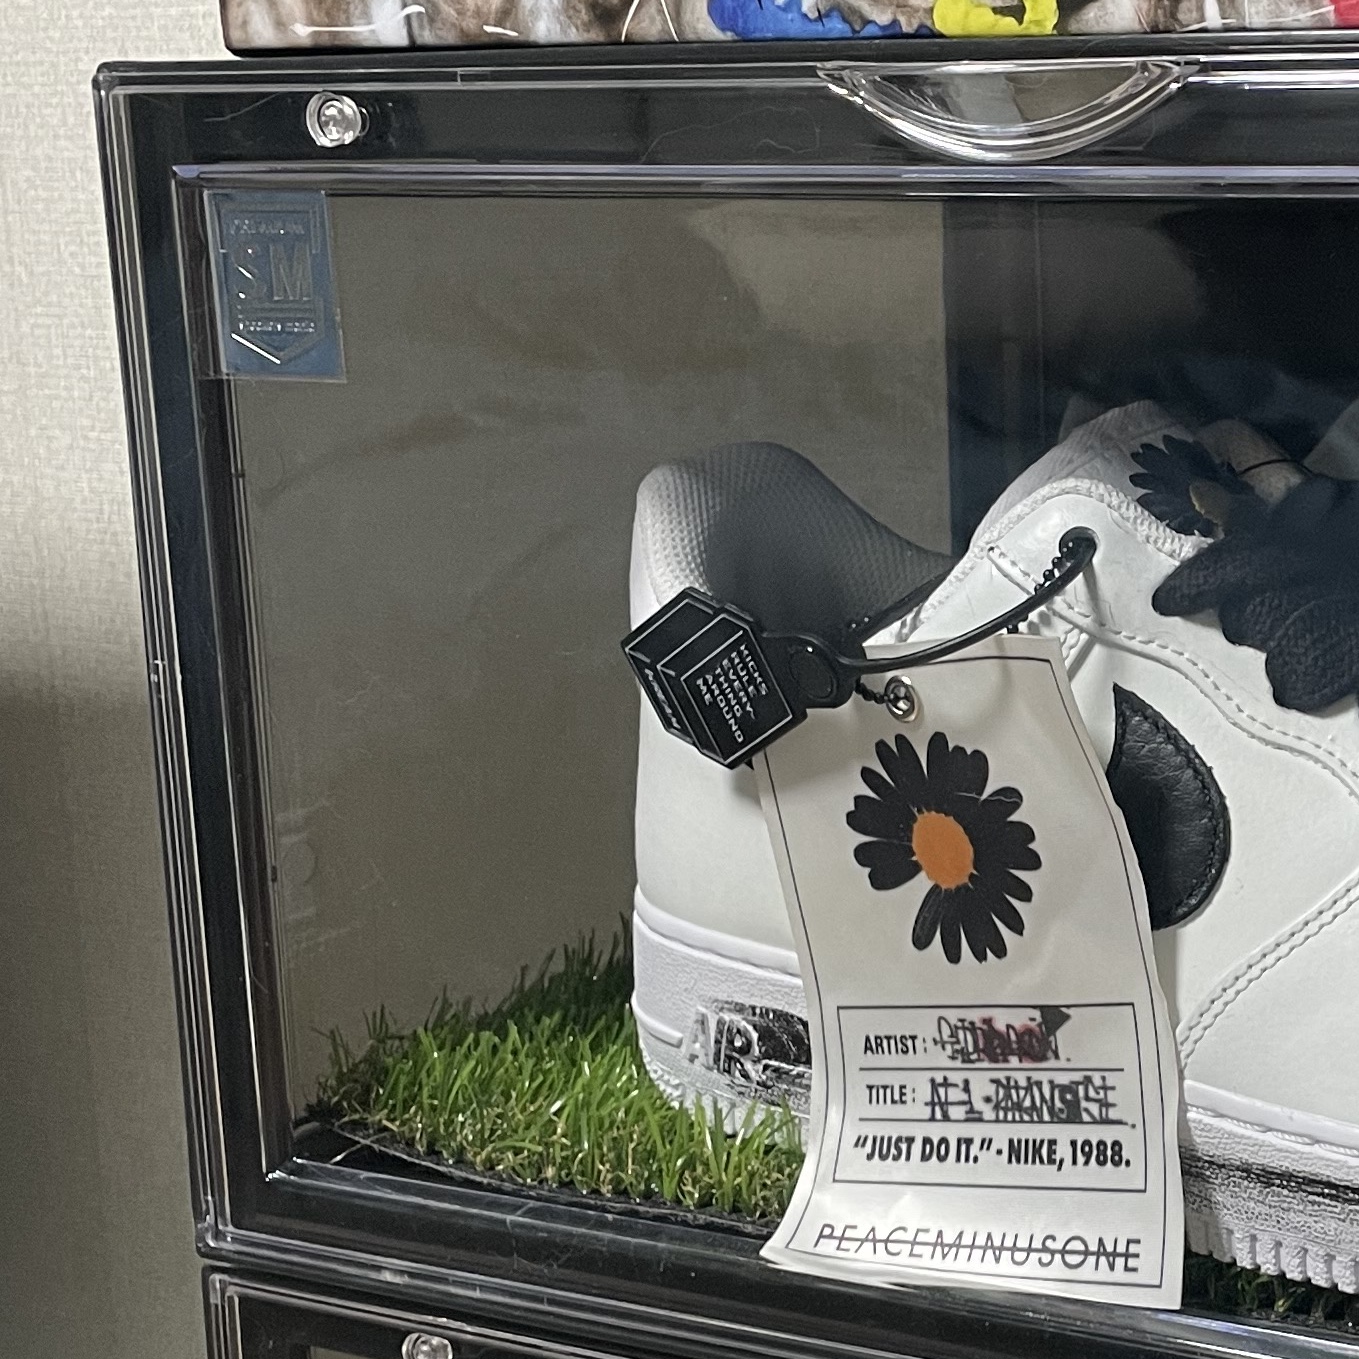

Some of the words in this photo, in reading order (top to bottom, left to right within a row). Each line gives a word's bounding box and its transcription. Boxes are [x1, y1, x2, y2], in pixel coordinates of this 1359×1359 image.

[696, 678, 713, 705] ME
[715, 663, 743, 717] THING
[731, 650, 757, 697] RULE
[740, 643, 768, 695] KICKS
[705, 674, 744, 742] AROUND
[920, 1136, 951, 1163] DO
[1069, 1139, 1131, 1168] 1988.
[813, 1223, 1141, 1273] PEACEMINUSONE
